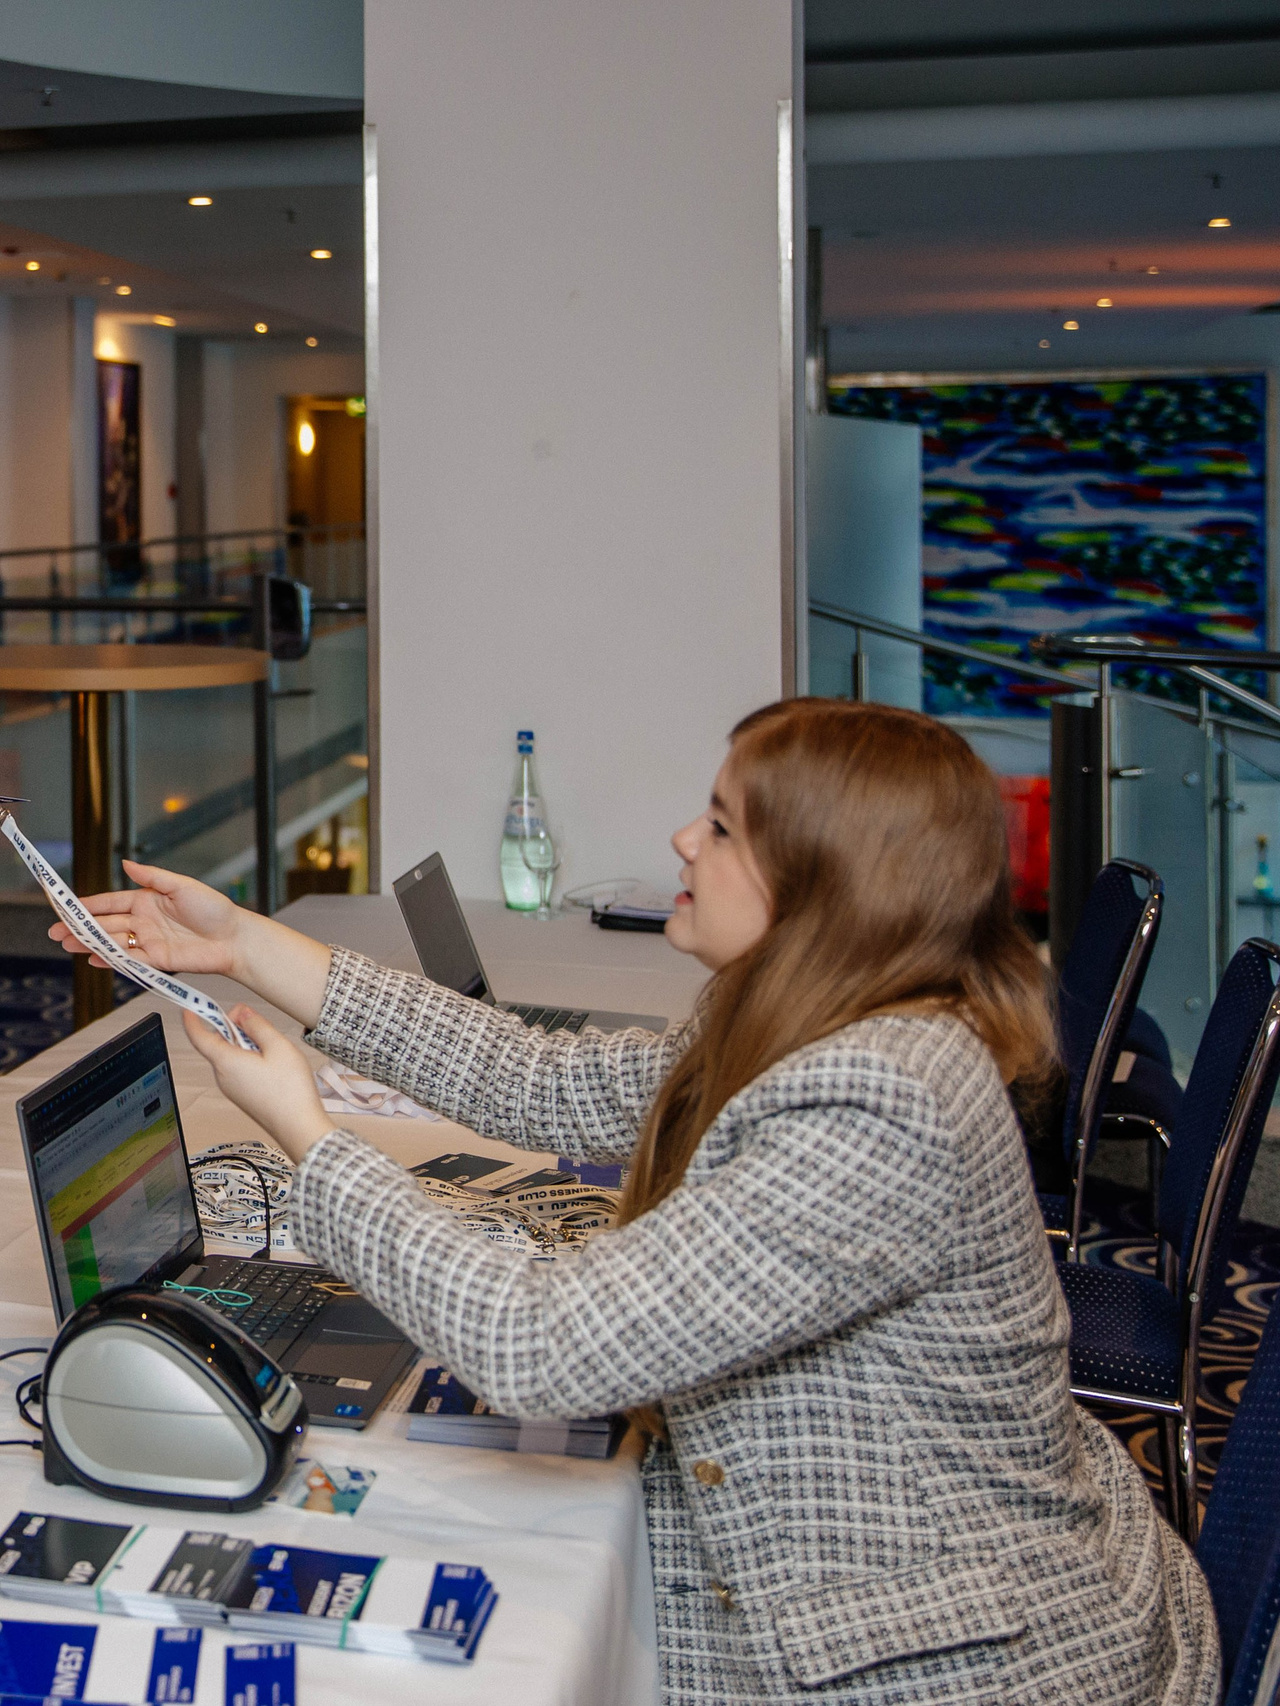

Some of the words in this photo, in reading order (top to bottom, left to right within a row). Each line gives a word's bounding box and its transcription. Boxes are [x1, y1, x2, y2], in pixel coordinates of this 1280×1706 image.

[64, 898, 87, 921] CLUB
[83, 919, 119, 954] BUSINESS
[517, 1190, 548, 1202] CLUB
[551, 1200, 597, 1211] ON.EU
